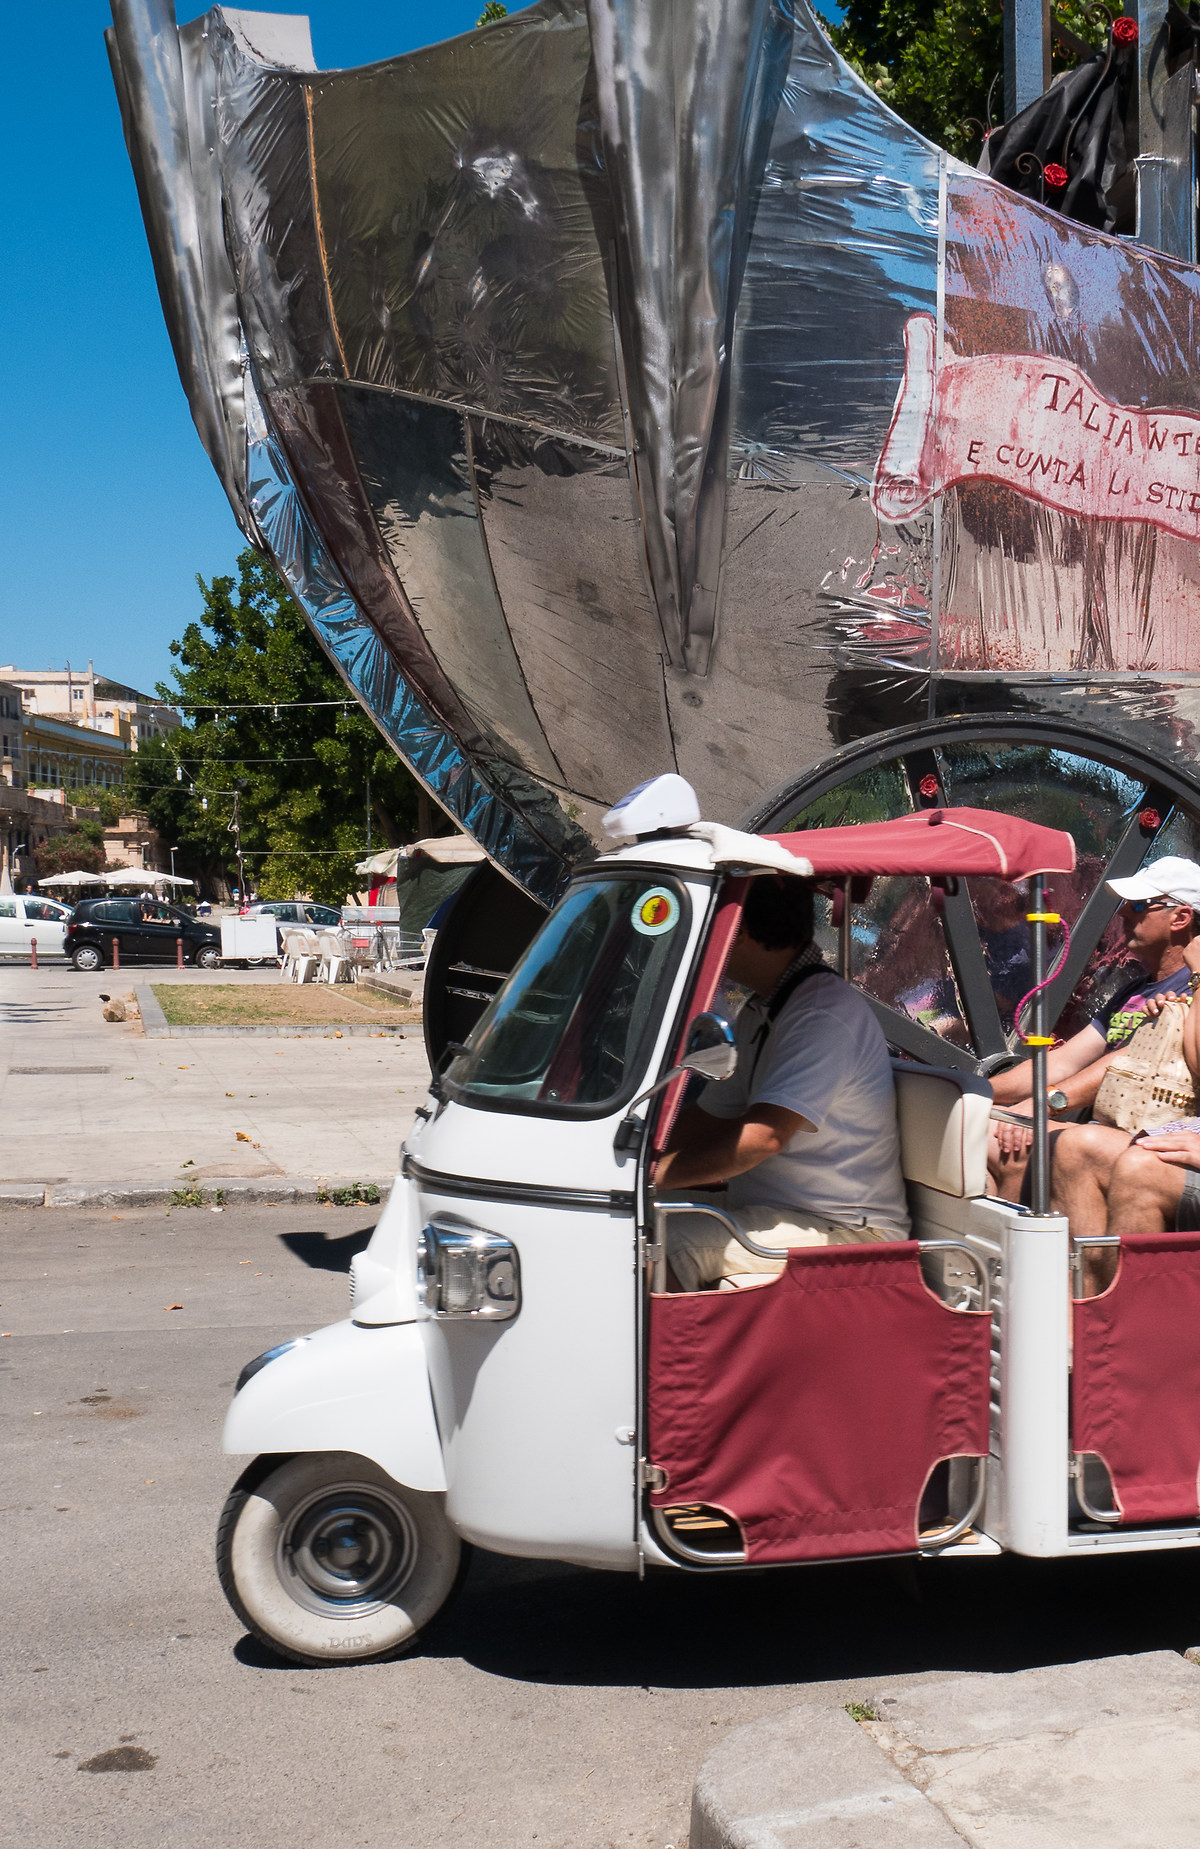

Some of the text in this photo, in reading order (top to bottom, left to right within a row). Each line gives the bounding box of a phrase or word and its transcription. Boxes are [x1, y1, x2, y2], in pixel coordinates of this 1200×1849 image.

[1041, 373, 1133, 454] TALIA
[966, 440, 985, 465] E
[996, 444, 1087, 491] CUNTA
[1108, 467, 1131, 495] LI
